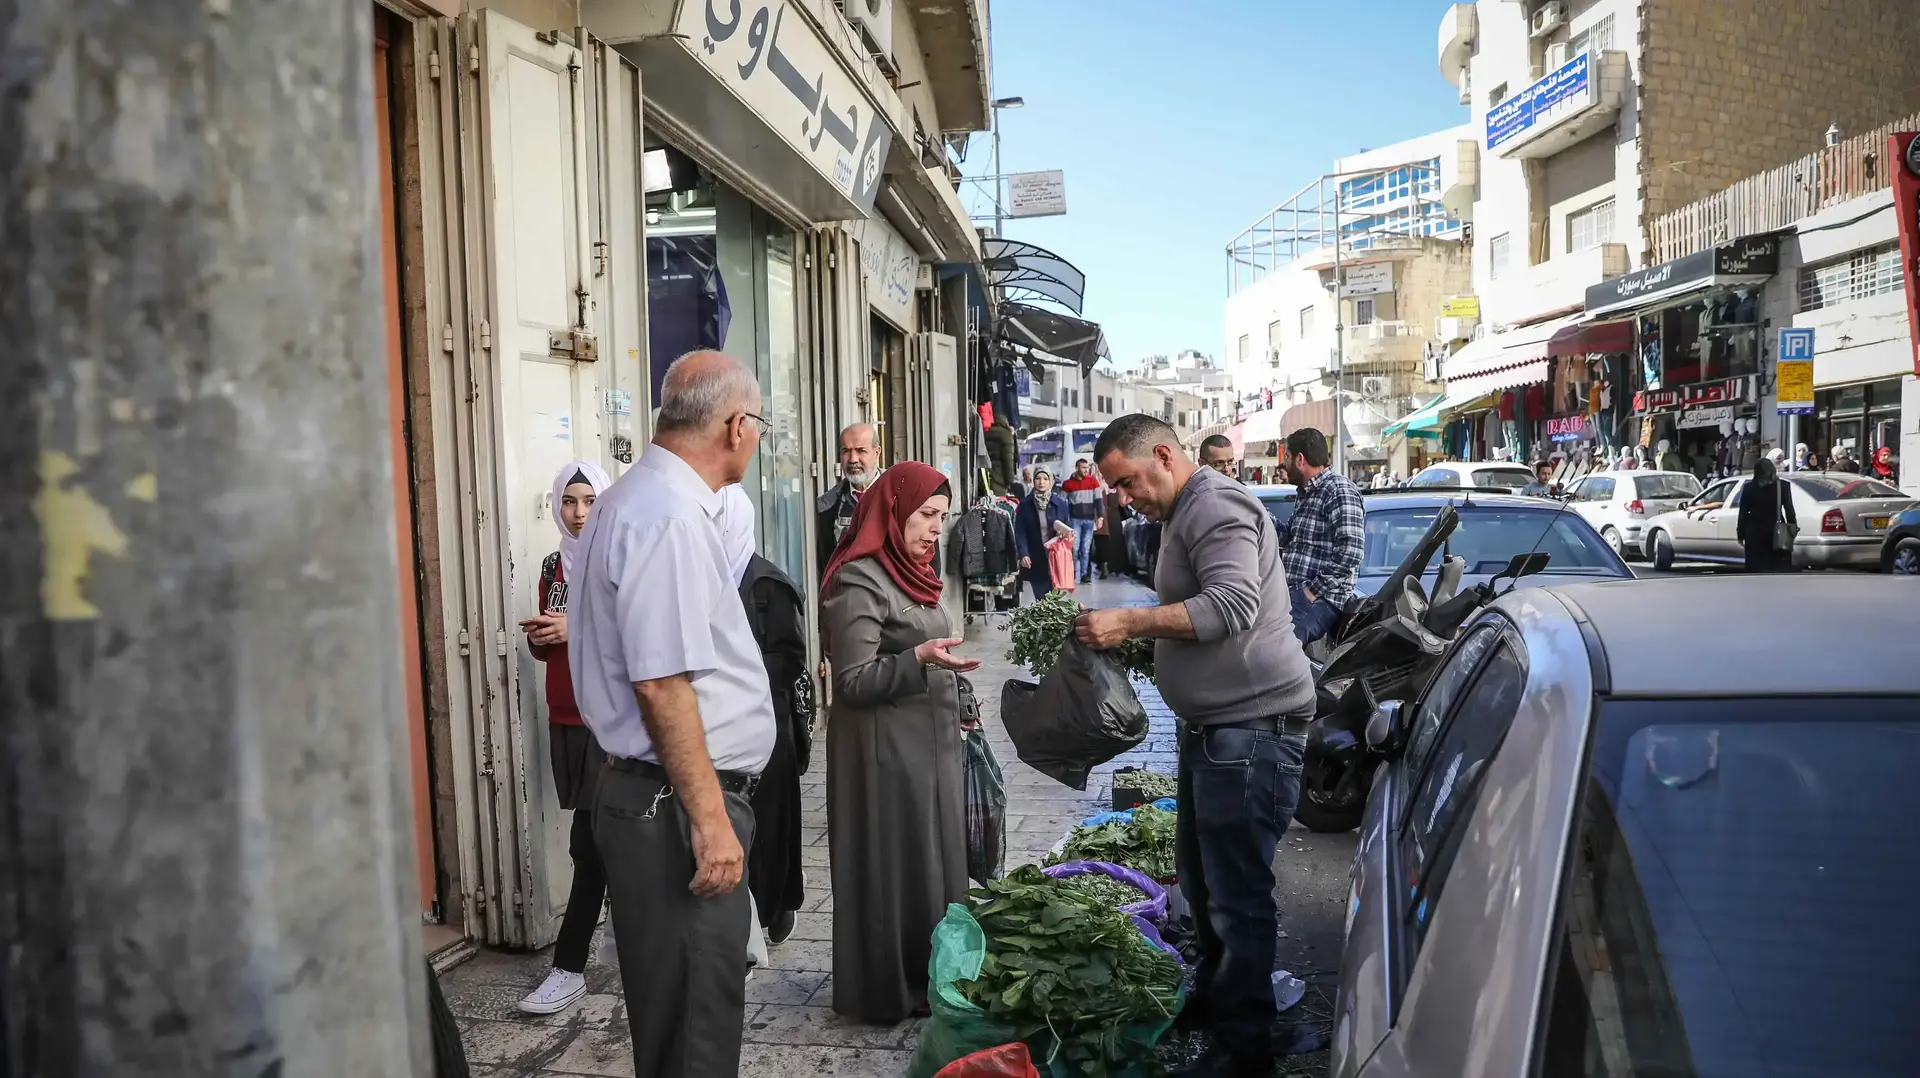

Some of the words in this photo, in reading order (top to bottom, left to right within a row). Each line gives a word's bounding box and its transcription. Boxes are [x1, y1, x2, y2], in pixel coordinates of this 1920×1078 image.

[703, 0, 860, 156] حرباوي
[1558, 59, 1585, 80] مؤسسة
[1741, 242, 1774, 260] الاصيل
[1721, 256, 1749, 273] سبورت
[1641, 265, 1671, 290] الاصيل
[1617, 279, 1641, 296] سبورت
